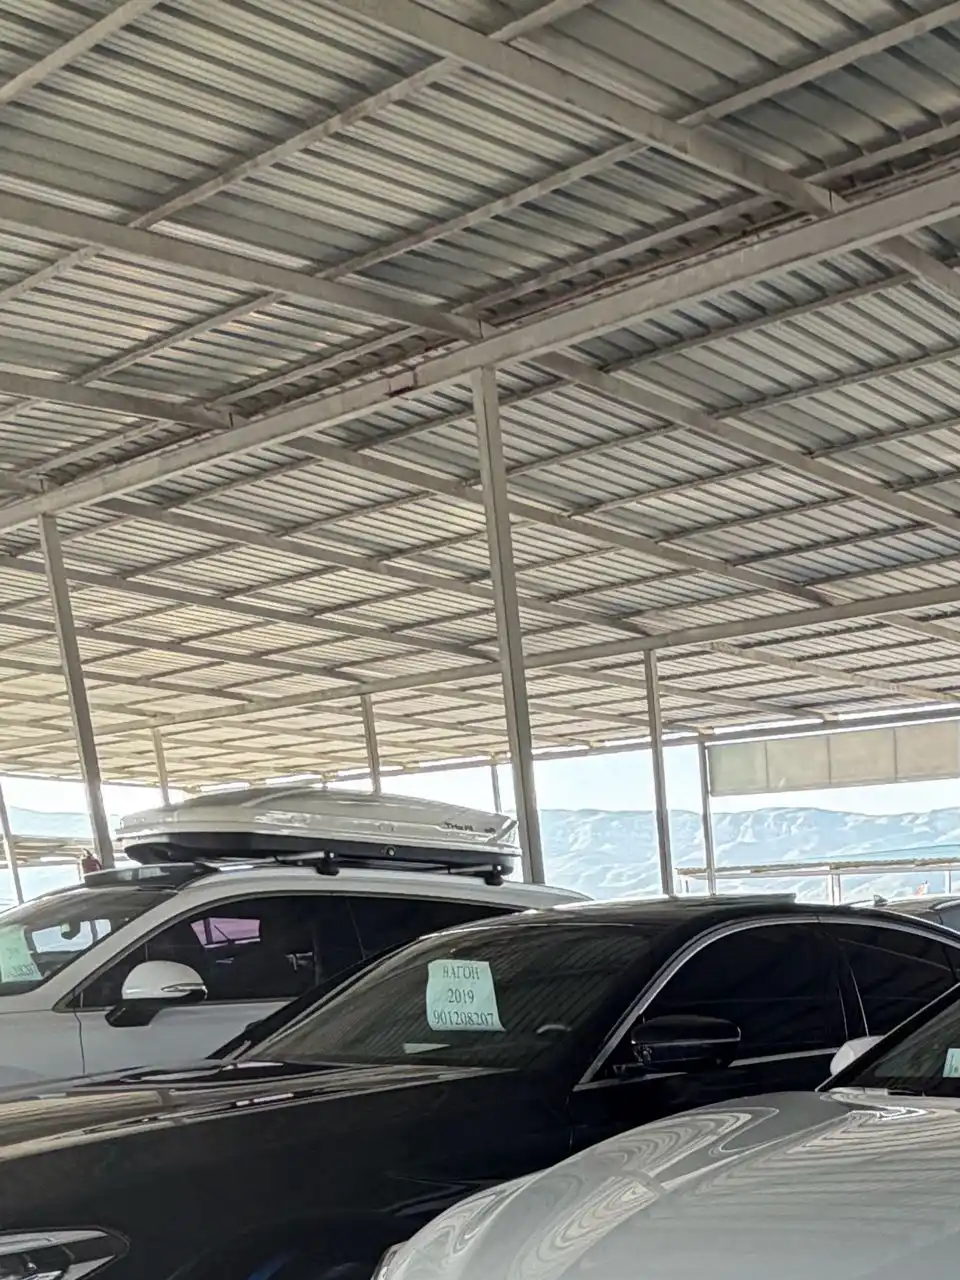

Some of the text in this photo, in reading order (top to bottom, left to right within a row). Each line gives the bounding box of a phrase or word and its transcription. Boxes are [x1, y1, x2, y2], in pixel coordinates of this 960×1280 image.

[442, 965, 480, 980] ВАГОН
[447, 988, 475, 1004] 2019
[433, 1009, 494, 1027] 901208207
